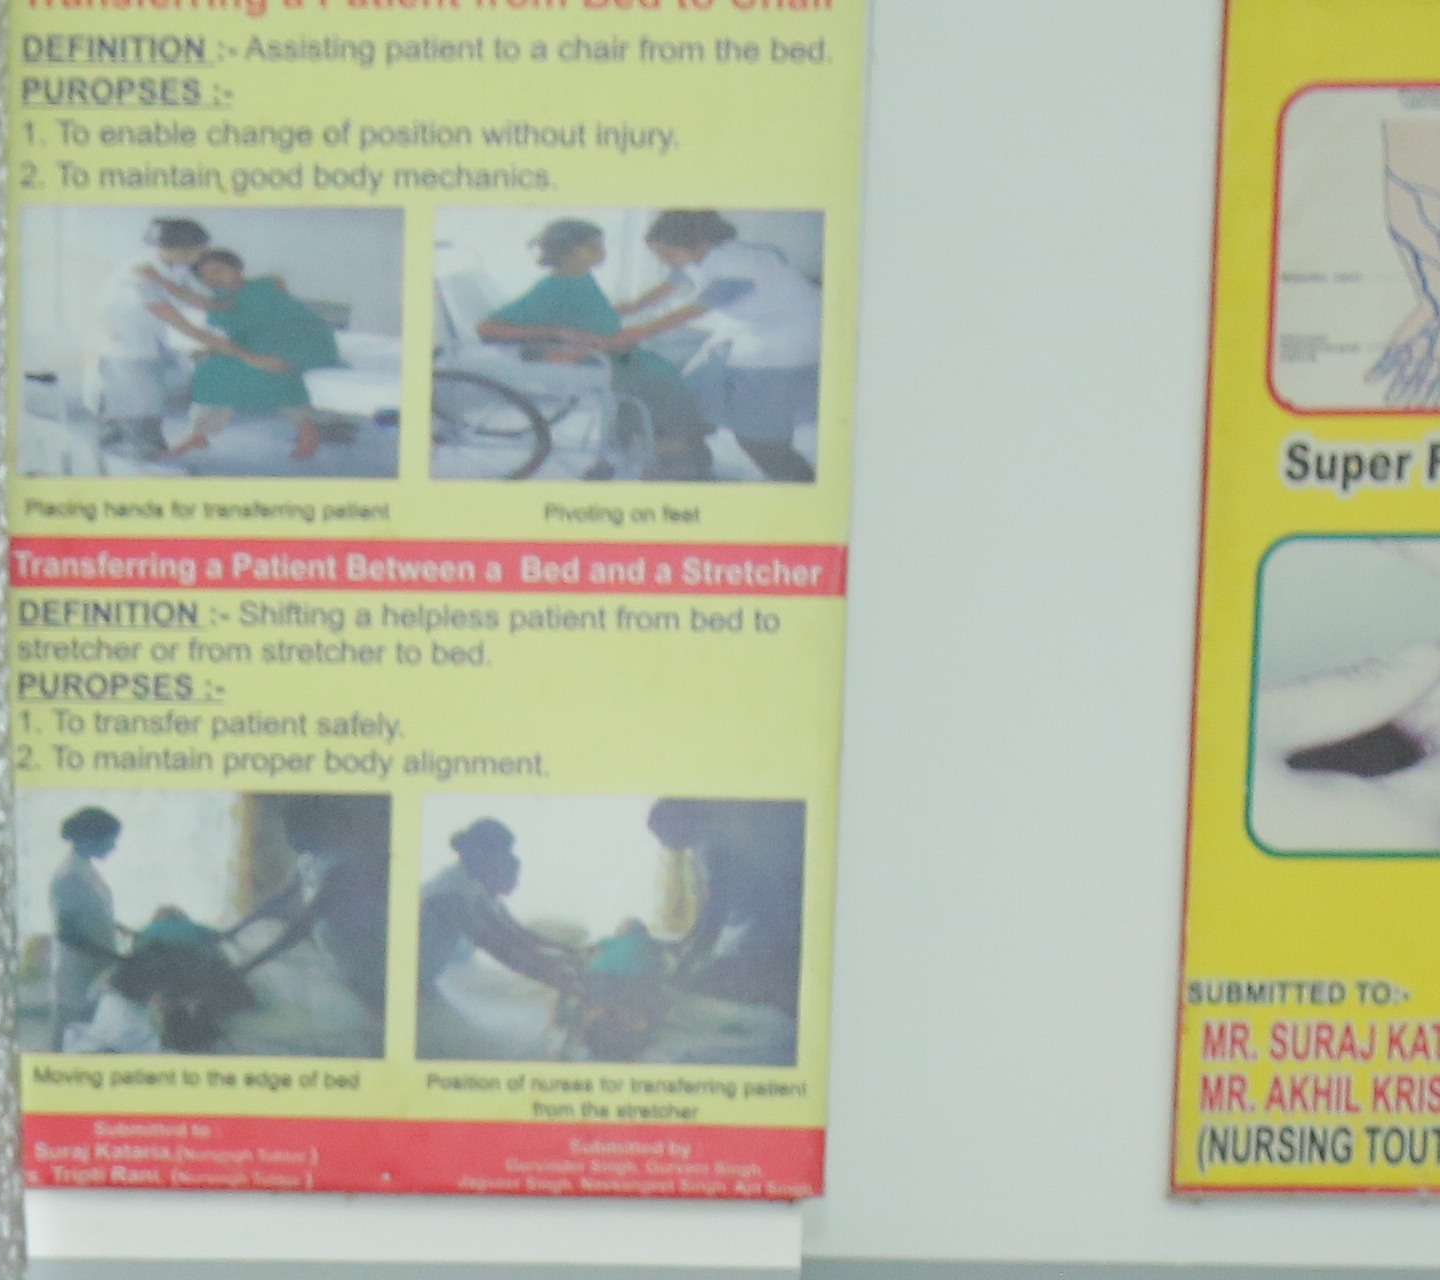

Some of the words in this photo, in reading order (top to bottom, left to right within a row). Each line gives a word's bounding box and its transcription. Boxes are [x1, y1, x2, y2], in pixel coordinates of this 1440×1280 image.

[22, 33, 206, 64] DEFINITION
[244, 34, 376, 67] Assisting
[386, 36, 484, 67] patient
[493, 37, 521, 63] to
[530, 42, 548, 63] a
[557, 35, 629, 63] chair
[639, 35, 704, 64] from
[715, 35, 760, 64] the
[771, 35, 832, 64] bed.
[22, 77, 201, 106] PUROPSES
[58, 119, 90, 147] To
[100, 121, 196, 148] enable
[207, 121, 313, 153] change
[323, 120, 351, 147] of
[359, 121, 472, 151] position
[481, 121, 586, 149] without
[595, 121, 680, 155] injury.
[58, 161, 89, 188] To
[98, 162, 221, 189] maintain
[232, 164, 303, 195] good
[313, 163, 383, 196] body
[394, 163, 558, 192] mechanics.
[1285, 441, 1411, 490] Super
[171, 500, 195, 519] for
[544, 502, 624, 526] Pivoting
[630, 507, 656, 523] on
[15, 550, 197, 586] Transferring
[205, 557, 222, 579] a
[231, 550, 337, 582] Patient
[346, 552, 477, 583] Between
[484, 560, 503, 583] a
[520, 553, 581, 585] Bed
[589, 556, 646, 585] and
[655, 562, 673, 585] a
[681, 555, 822, 587] Stretcher
[20, 600, 198, 626] DEFINITION
[240, 602, 345, 632] Shifting
[355, 608, 372, 628] a
[382, 603, 500, 632] helpless
[510, 606, 606, 633] patient
[615, 604, 681, 631] from
[691, 606, 744, 632] bed
[754, 608, 780, 632] to
[18, 638, 142, 663] stretcher
[151, 643, 177, 663] or
[189, 637, 251, 663] from
[263, 638, 384, 664] stretcher
[396, 640, 422, 664] to
[432, 640, 491, 665] bed.
[19, 672, 193, 699] PUROPSES
[53, 708, 84, 735] To
[94, 709, 203, 736] transfer
[212, 711, 308, 740] patient
[317, 711, 404, 743] safely.
[53, 744, 84, 771] To
[93, 745, 214, 772] maintain
[223, 751, 315, 776] proper
[325, 748, 392, 777] body
[404, 750, 549, 779] alignment.
[1188, 980, 1346, 1005] SUBMITTED
[1201, 1021, 1258, 1062] MR.
[1269, 1021, 1377, 1062] SURAJ
[1200, 1074, 1256, 1113] MR.
[1266, 1074, 1362, 1114] AKHIL
[1197, 1126, 1353, 1173] (NURSING
